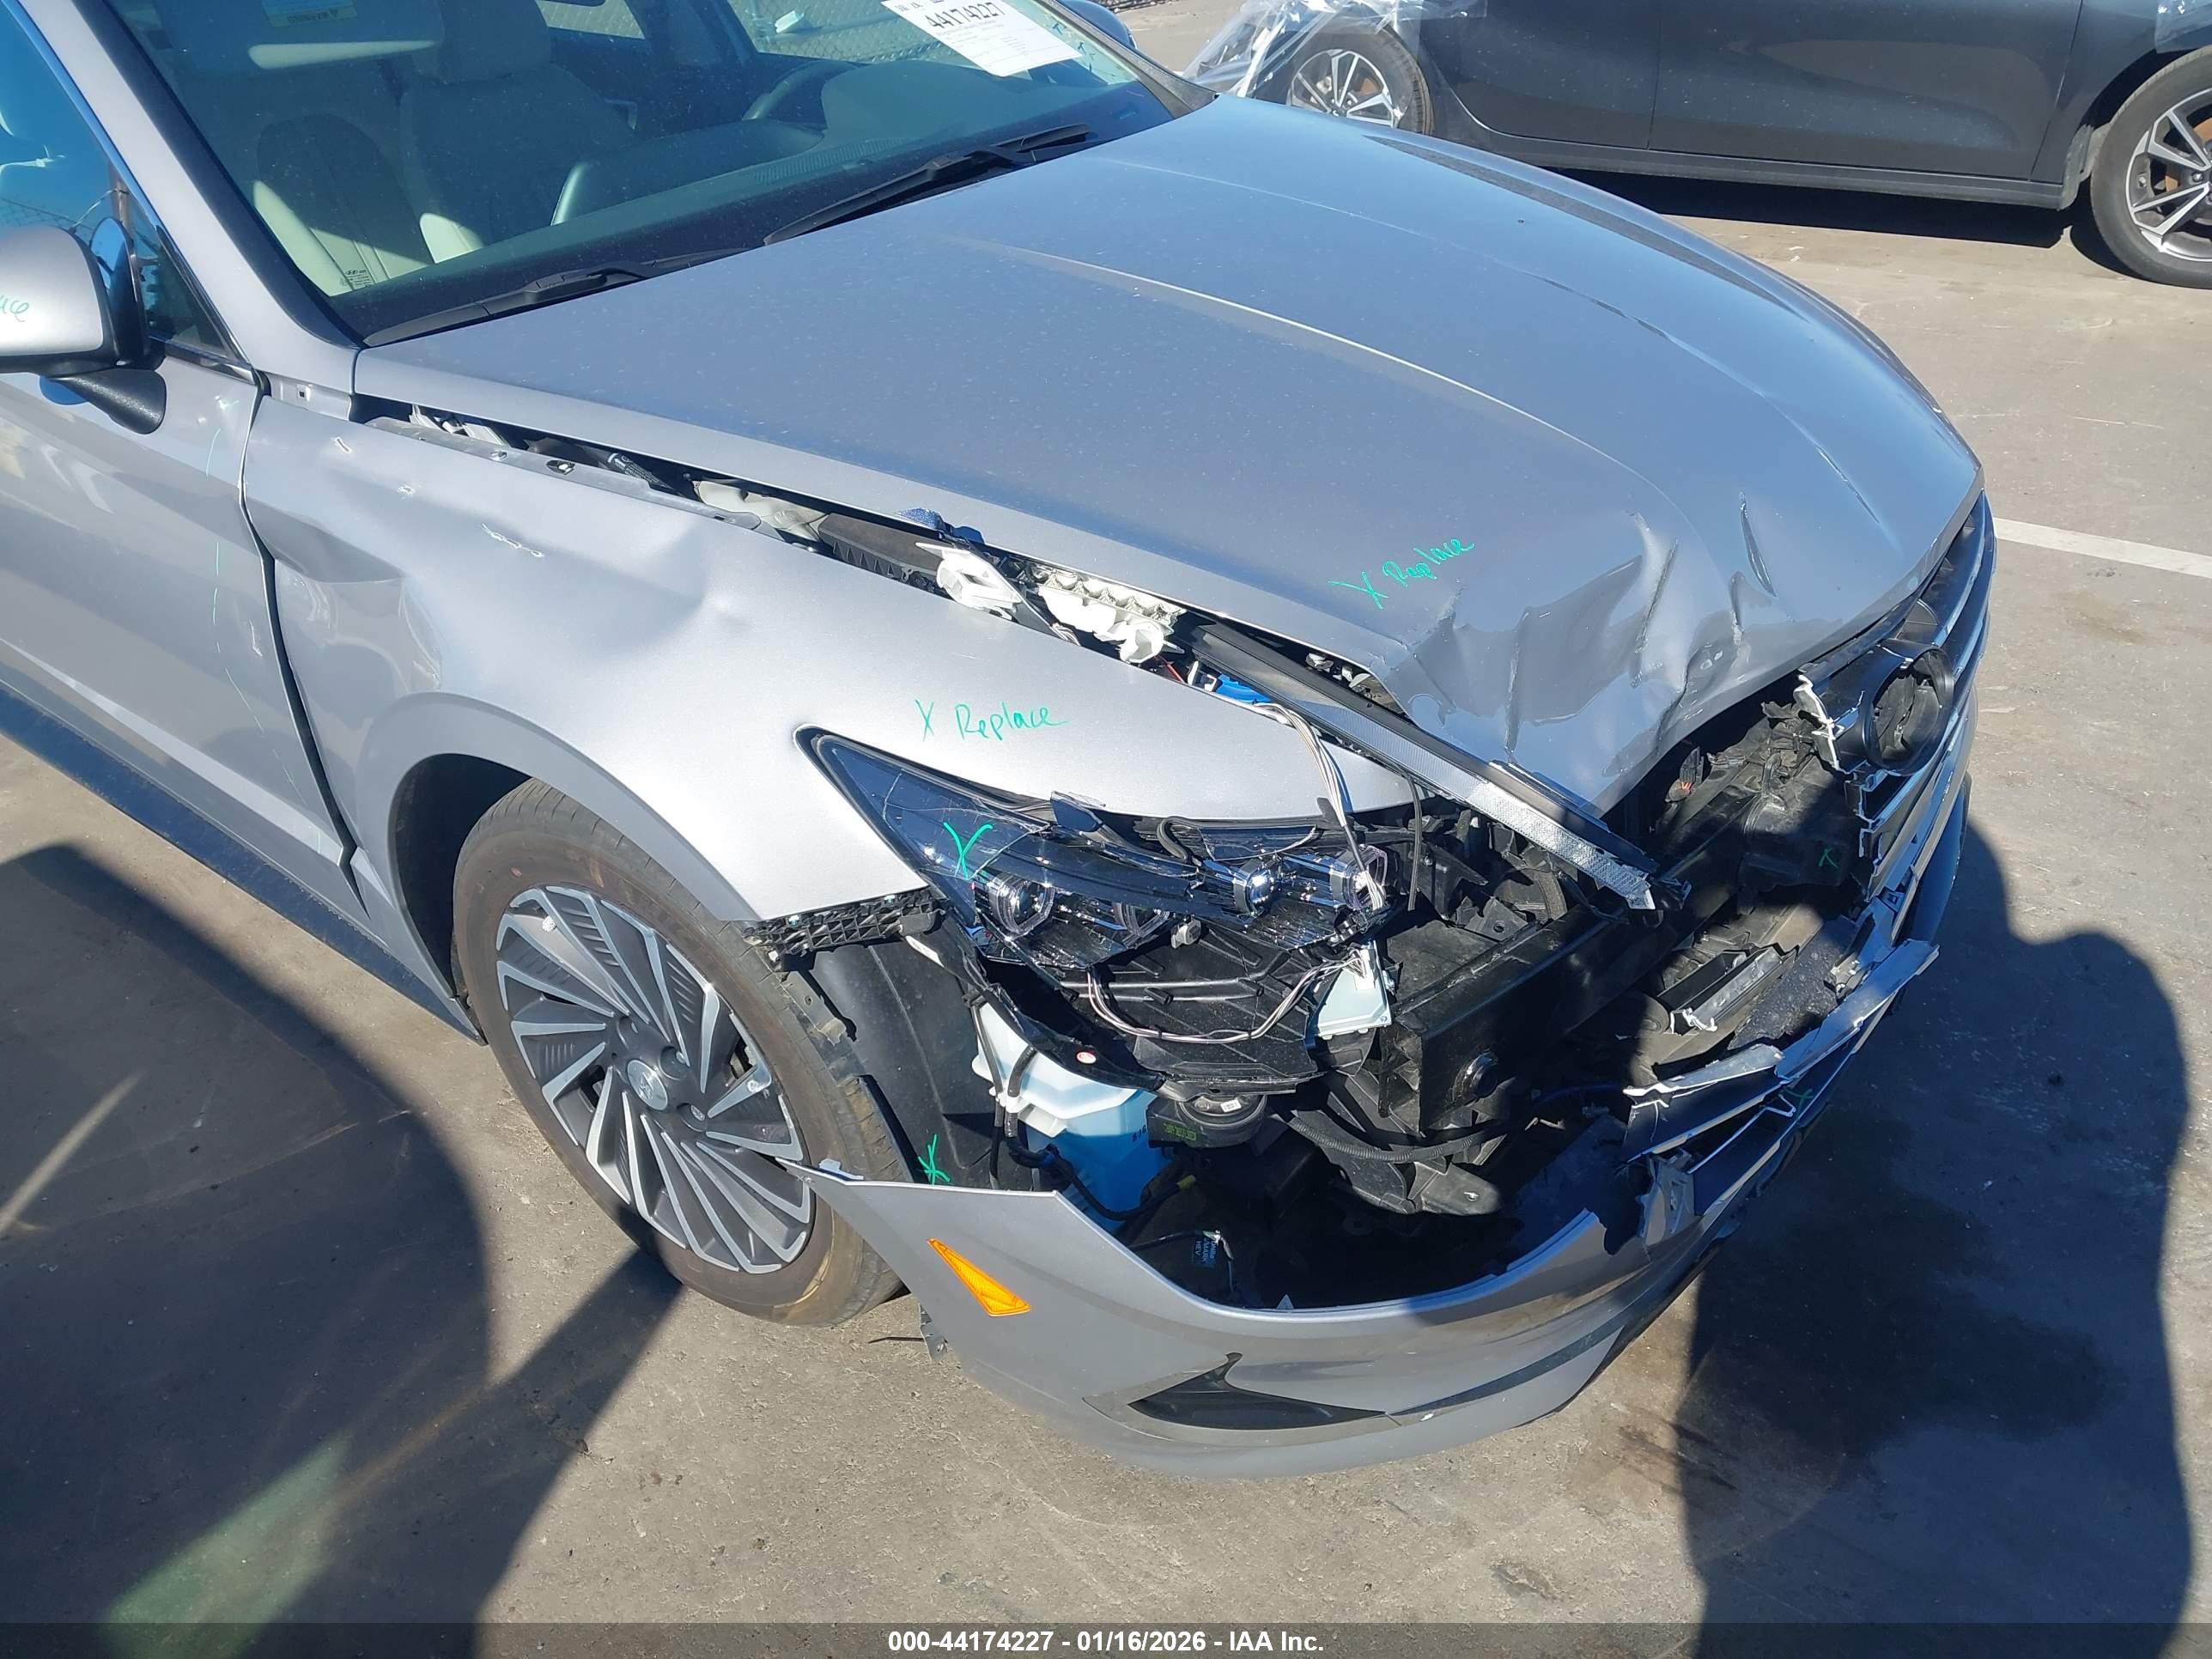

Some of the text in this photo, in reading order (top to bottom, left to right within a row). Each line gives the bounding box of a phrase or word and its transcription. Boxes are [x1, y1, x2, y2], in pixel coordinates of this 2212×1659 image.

[925, 2, 1006, 28] 44174227
[1382, 538, 1475, 587] Replace
[915, 699, 1070, 742] X Replace
